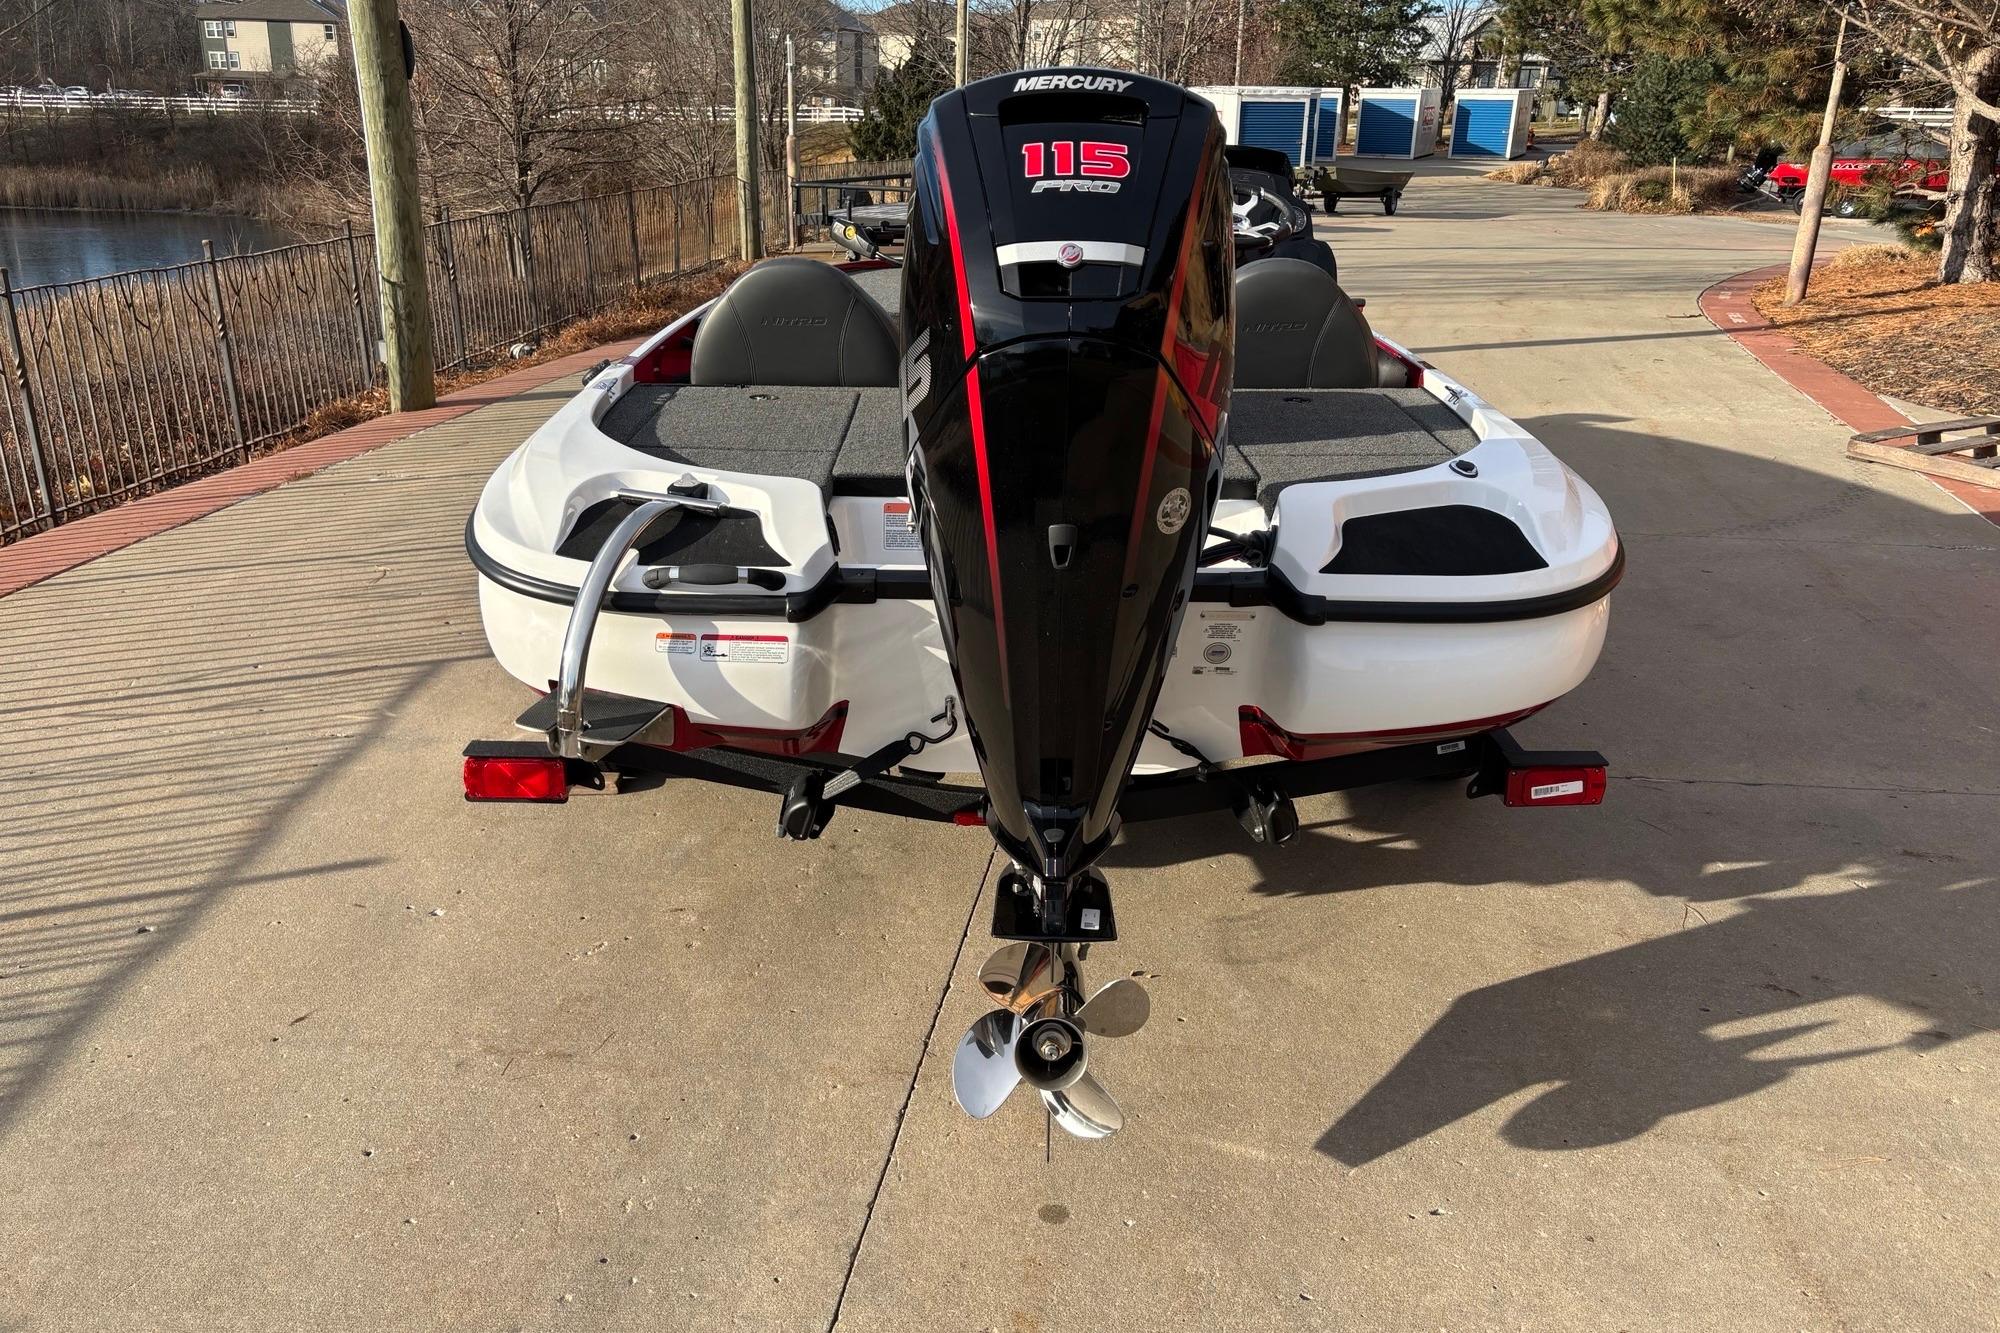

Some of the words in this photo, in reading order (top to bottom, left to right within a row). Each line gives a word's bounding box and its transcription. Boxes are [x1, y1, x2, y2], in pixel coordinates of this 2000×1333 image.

[1013, 75, 1134, 93] MERCURY
[1022, 141, 1131, 179] 115
[1031, 179, 1122, 194] PRO
